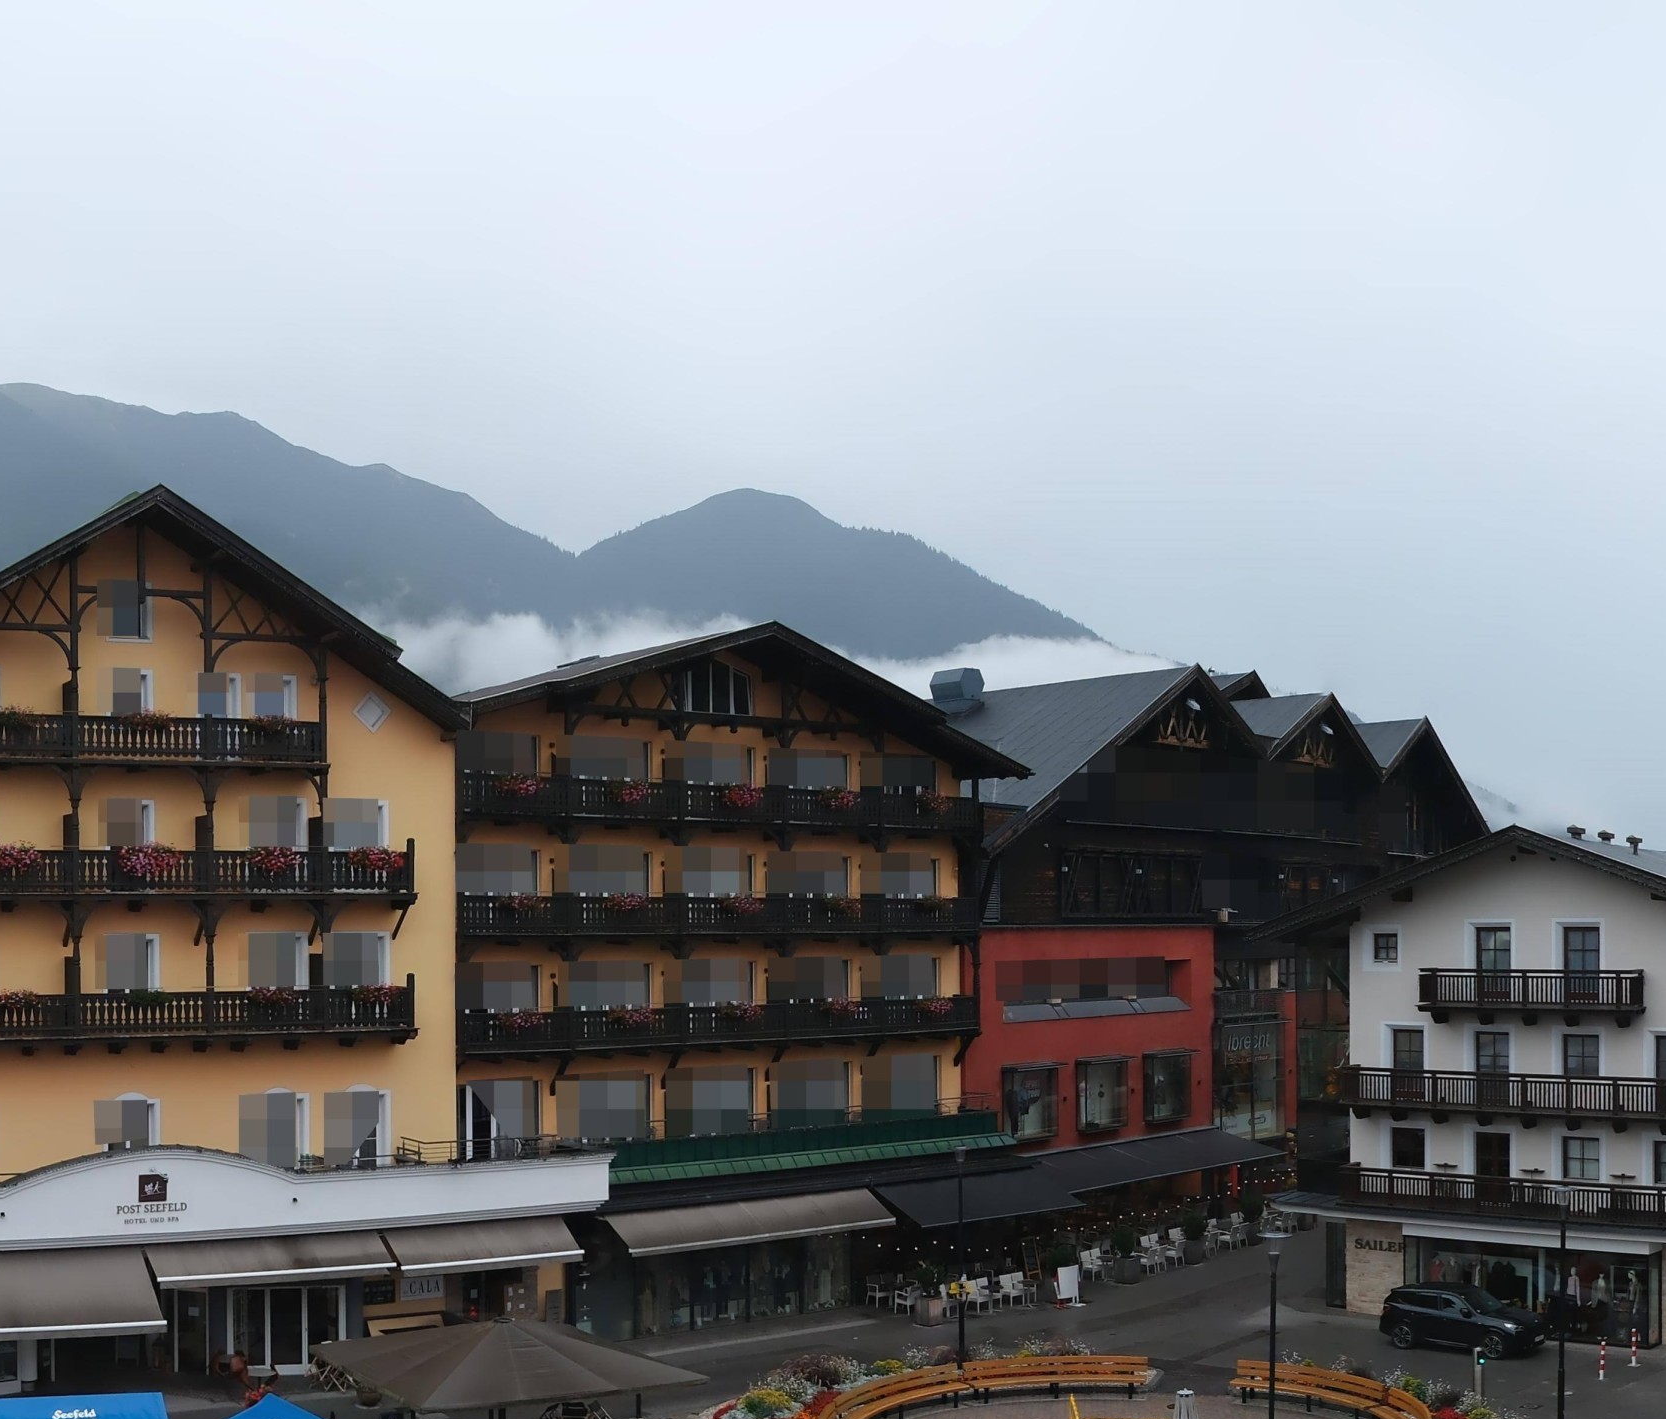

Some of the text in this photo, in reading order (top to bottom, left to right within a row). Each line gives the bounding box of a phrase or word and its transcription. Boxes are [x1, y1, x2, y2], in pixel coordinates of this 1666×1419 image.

[117, 1202, 187, 1214] POST SEEFELD
[1355, 1238, 1405, 1254] SAILER
[409, 1280, 440, 1294] CALA
